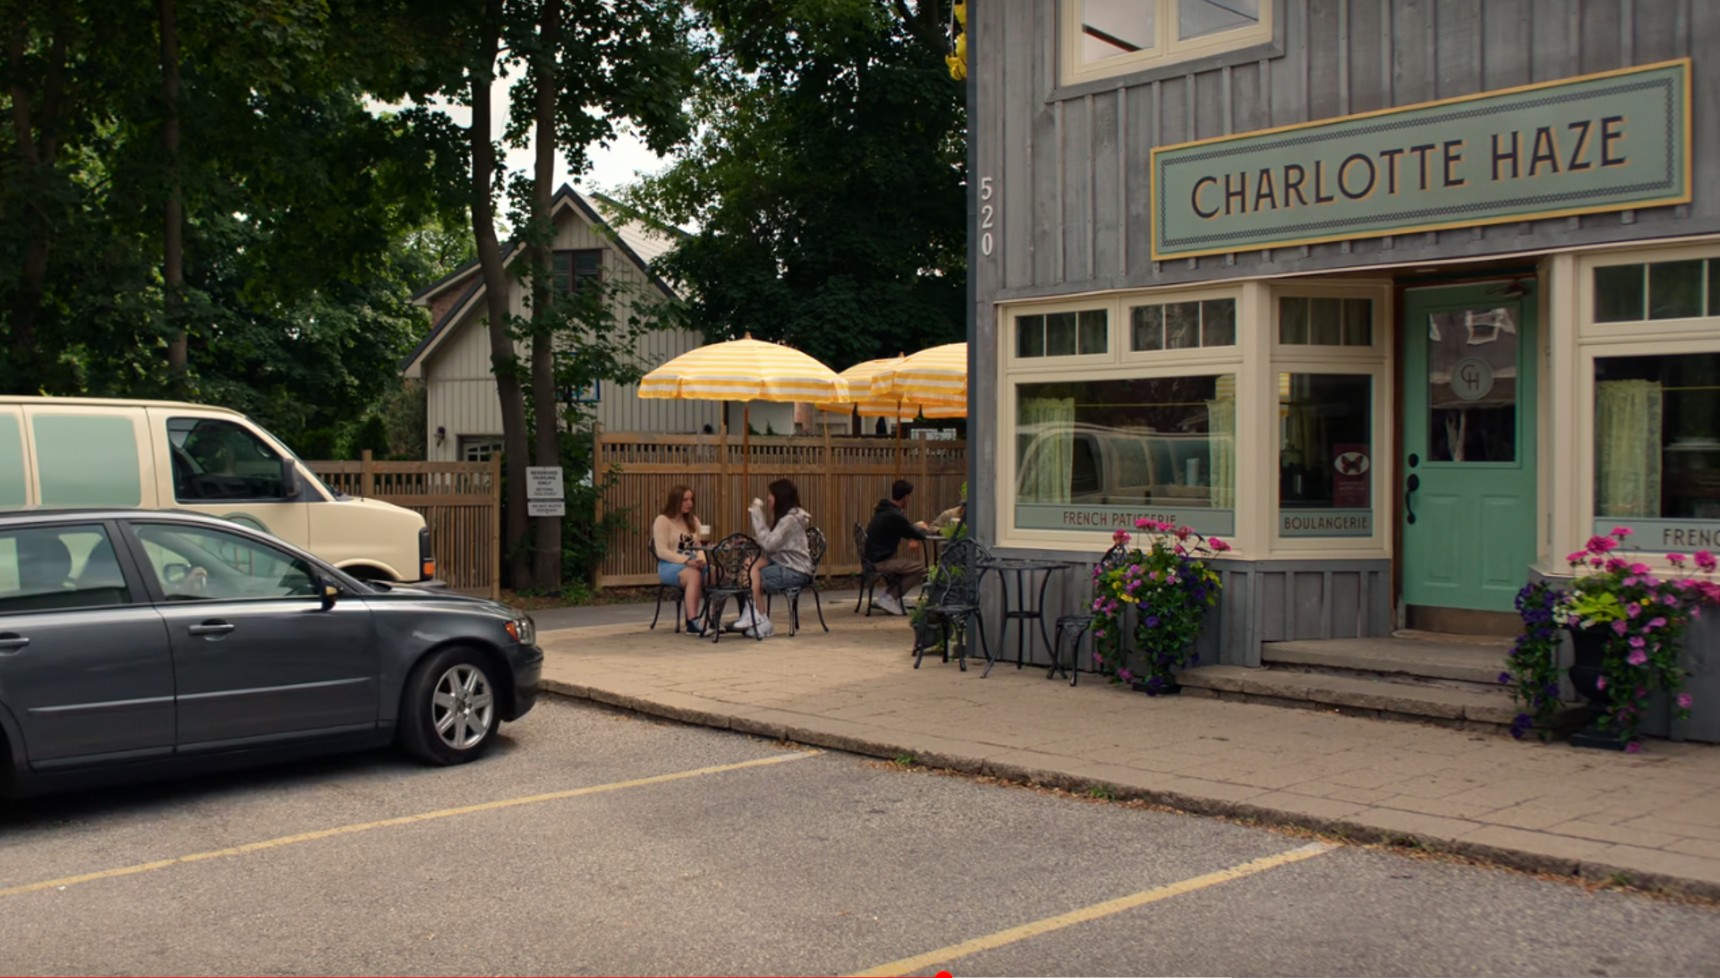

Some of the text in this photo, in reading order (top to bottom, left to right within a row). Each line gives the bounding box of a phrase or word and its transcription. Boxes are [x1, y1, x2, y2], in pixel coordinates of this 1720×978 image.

[1191, 115, 1628, 219] CHARLOTTE HAZE
[981, 177, 993, 256] 520
[1063, 511, 1107, 526] FRENCH
[1284, 516, 1368, 530] BOULANGERIE
